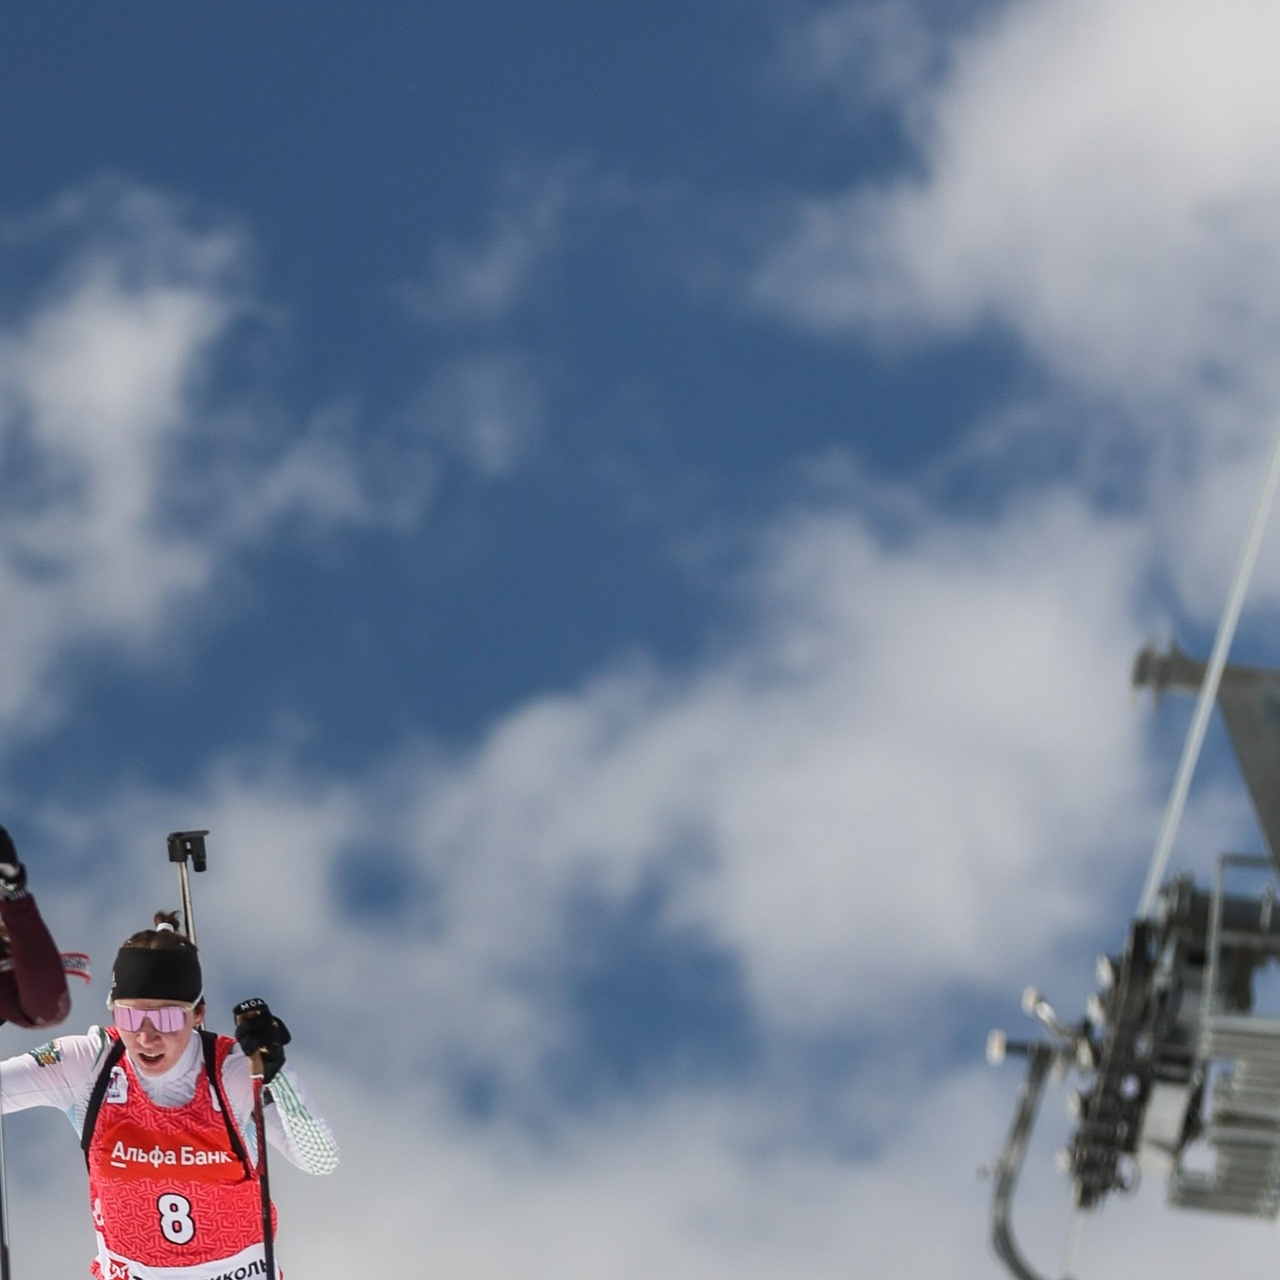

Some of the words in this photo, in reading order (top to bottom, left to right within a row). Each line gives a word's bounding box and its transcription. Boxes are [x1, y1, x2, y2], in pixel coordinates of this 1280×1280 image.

[110, 1140, 176, 1168] Альфа
[181, 1146, 232, 1166] Банк
[157, 1193, 195, 1245] 8
